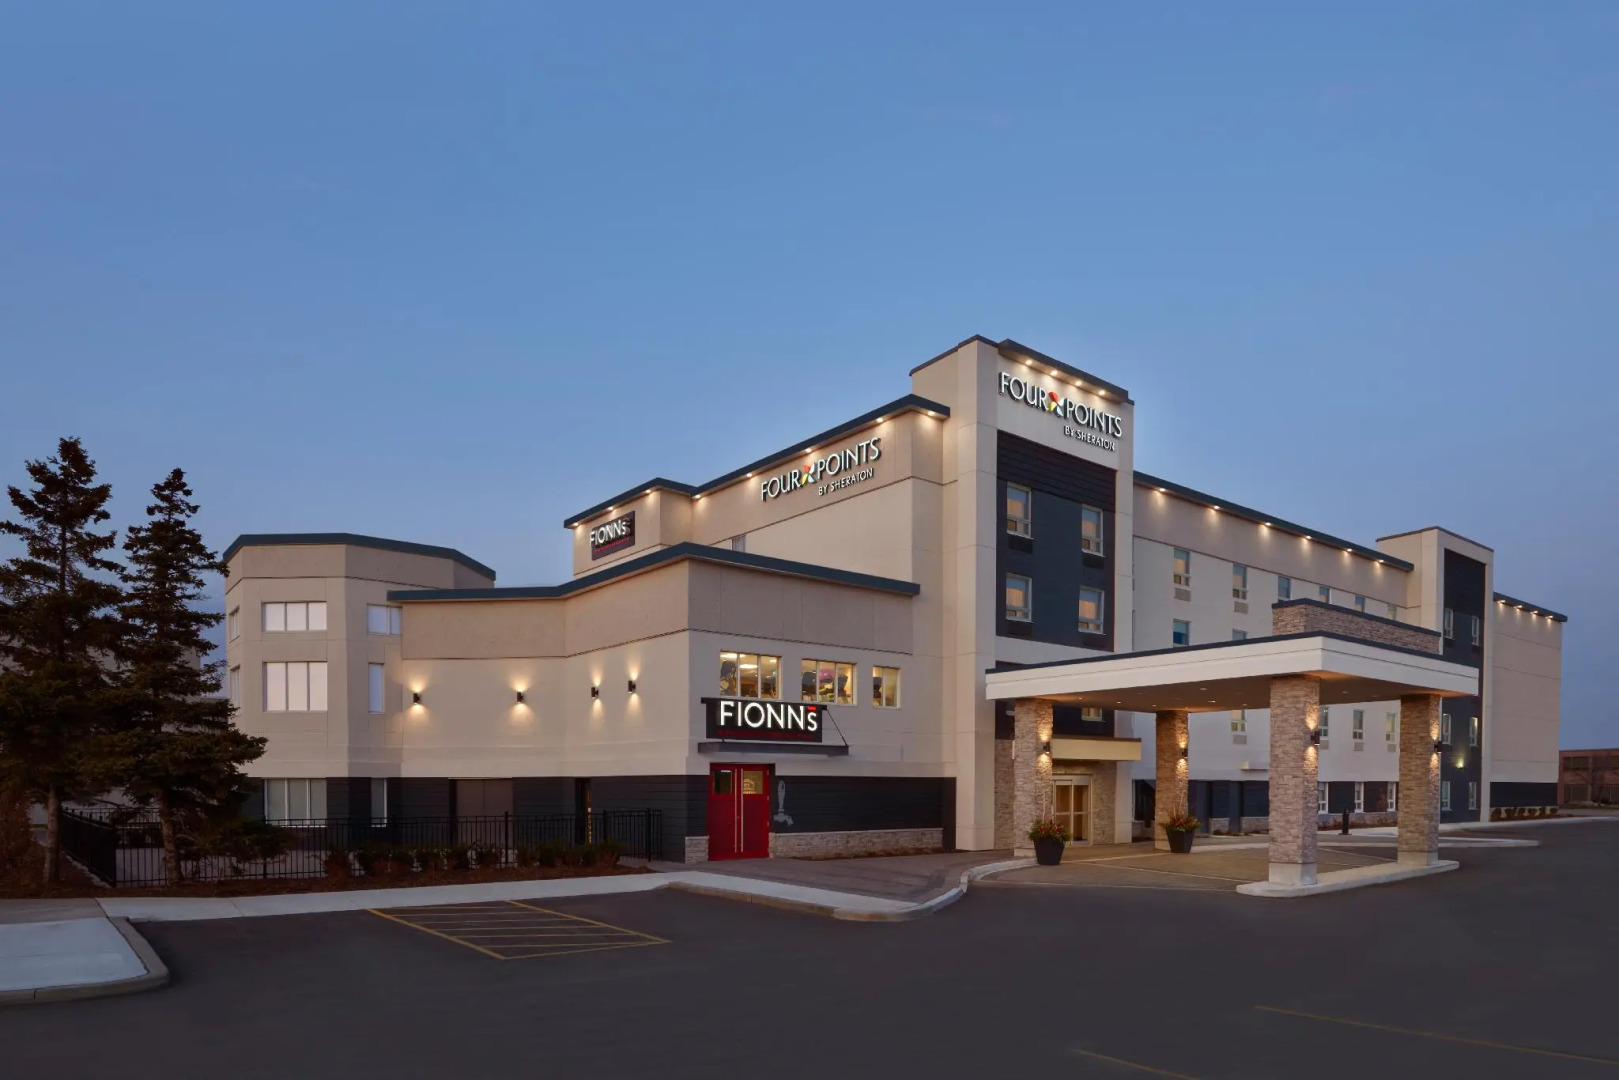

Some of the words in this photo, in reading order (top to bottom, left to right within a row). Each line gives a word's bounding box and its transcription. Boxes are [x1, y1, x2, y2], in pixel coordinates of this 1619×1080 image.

[1000, 372, 1049, 410] FOUR
[1066, 398, 1122, 438] POINTS
[1064, 425, 1074, 437] BY
[1077, 430, 1115, 451] SHERATON
[761, 470, 801, 501] FOUR
[817, 437, 880, 480] POINTS
[818, 484, 829, 496] BY
[830, 468, 873, 492] SHERATON
